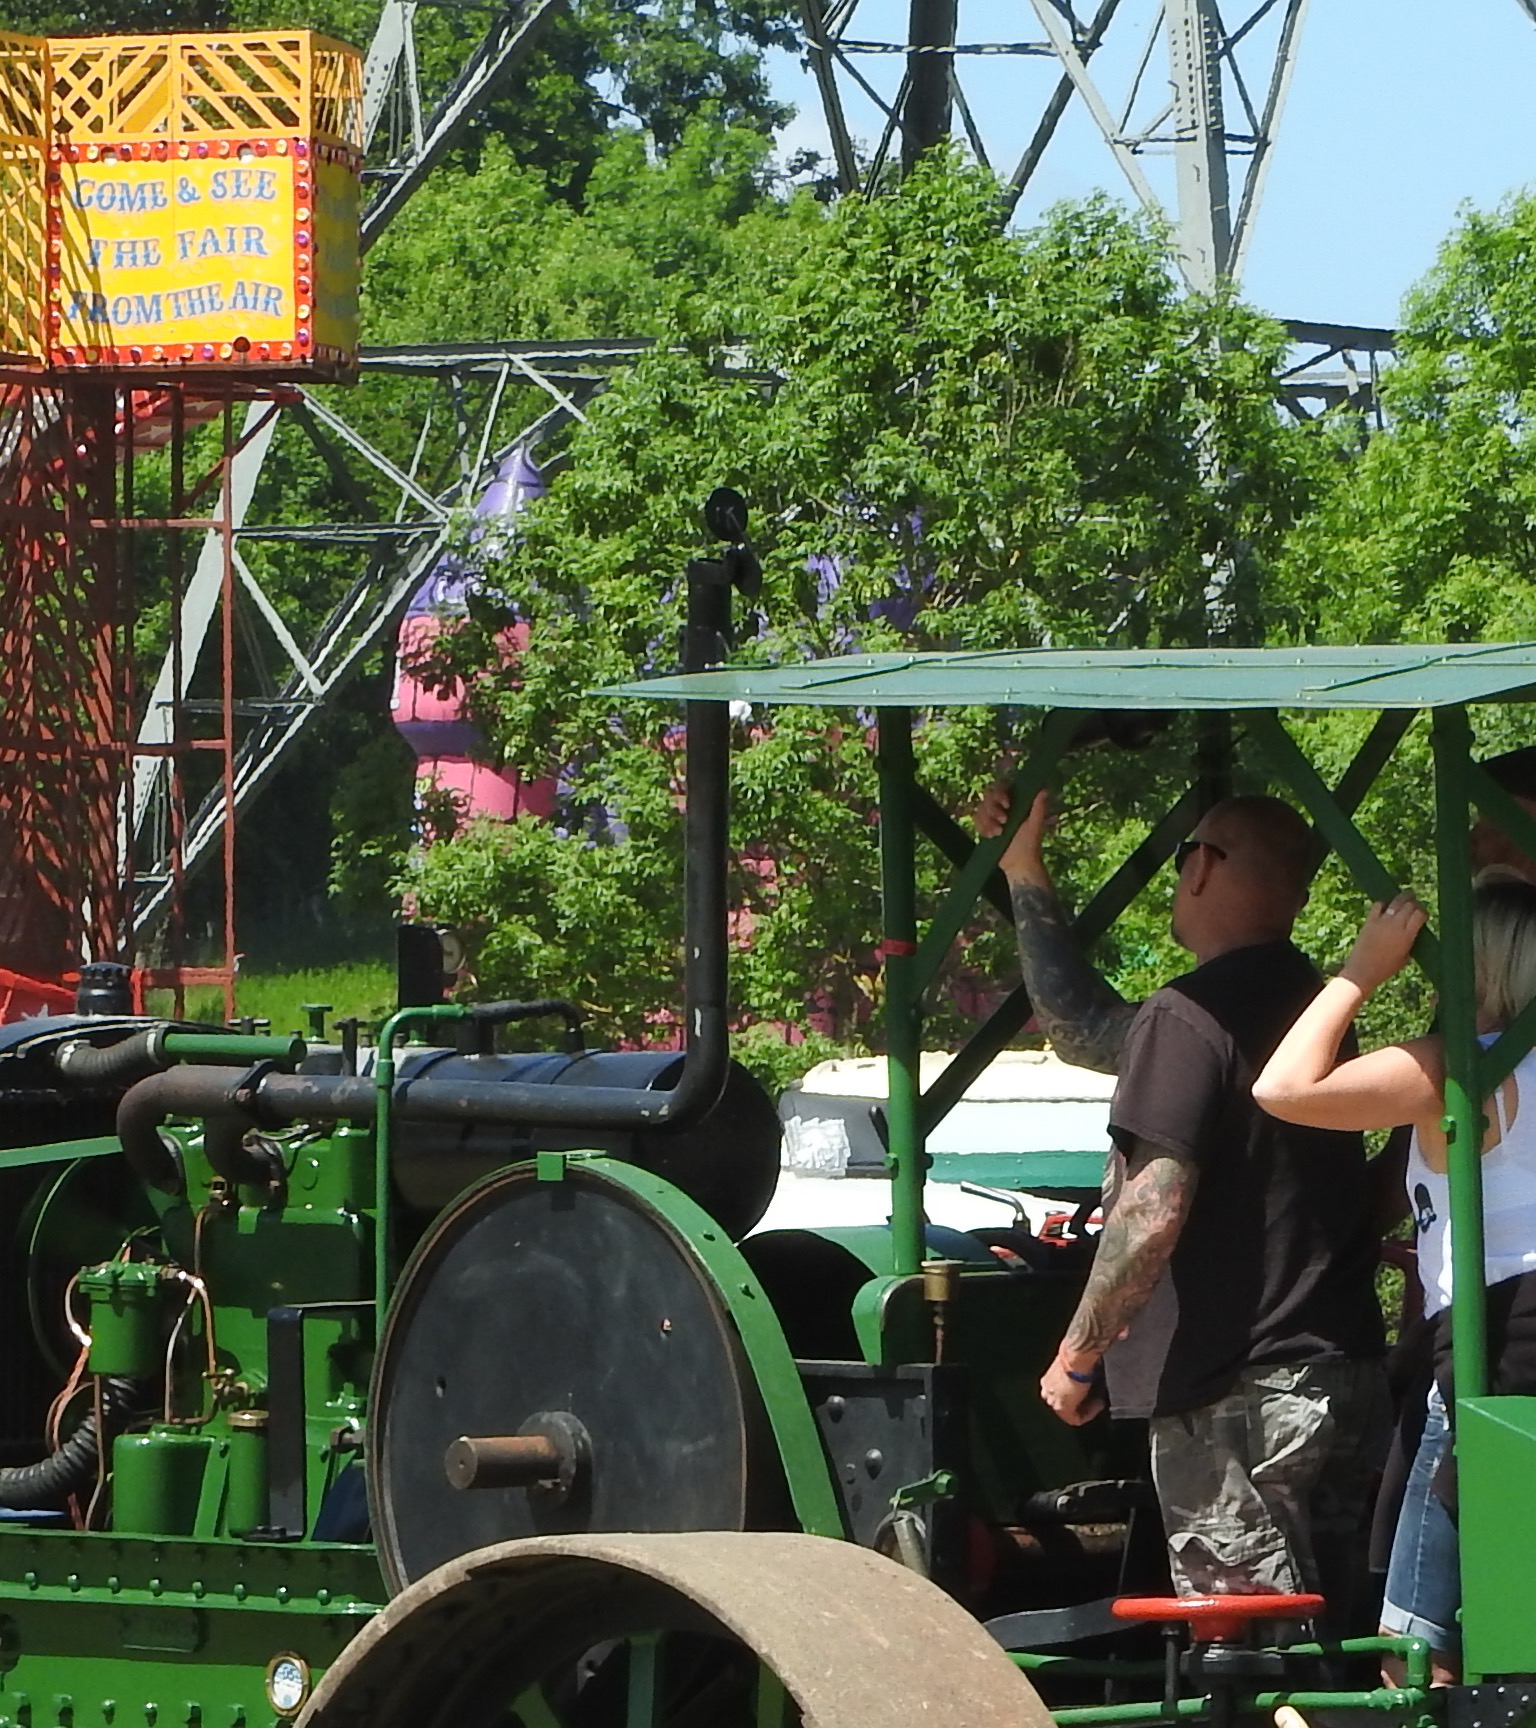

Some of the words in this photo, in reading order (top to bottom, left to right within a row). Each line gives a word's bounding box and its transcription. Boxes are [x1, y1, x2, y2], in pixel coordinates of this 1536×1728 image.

[73, 178, 169, 213] COME
[177, 176, 201, 203] &
[211, 168, 277, 201] SEE
[88, 237, 162, 269] THE
[176, 226, 269, 260] FAIR
[67, 290, 165, 326] FROM
[166, 282, 225, 320] THE
[227, 280, 284, 318] AIR
